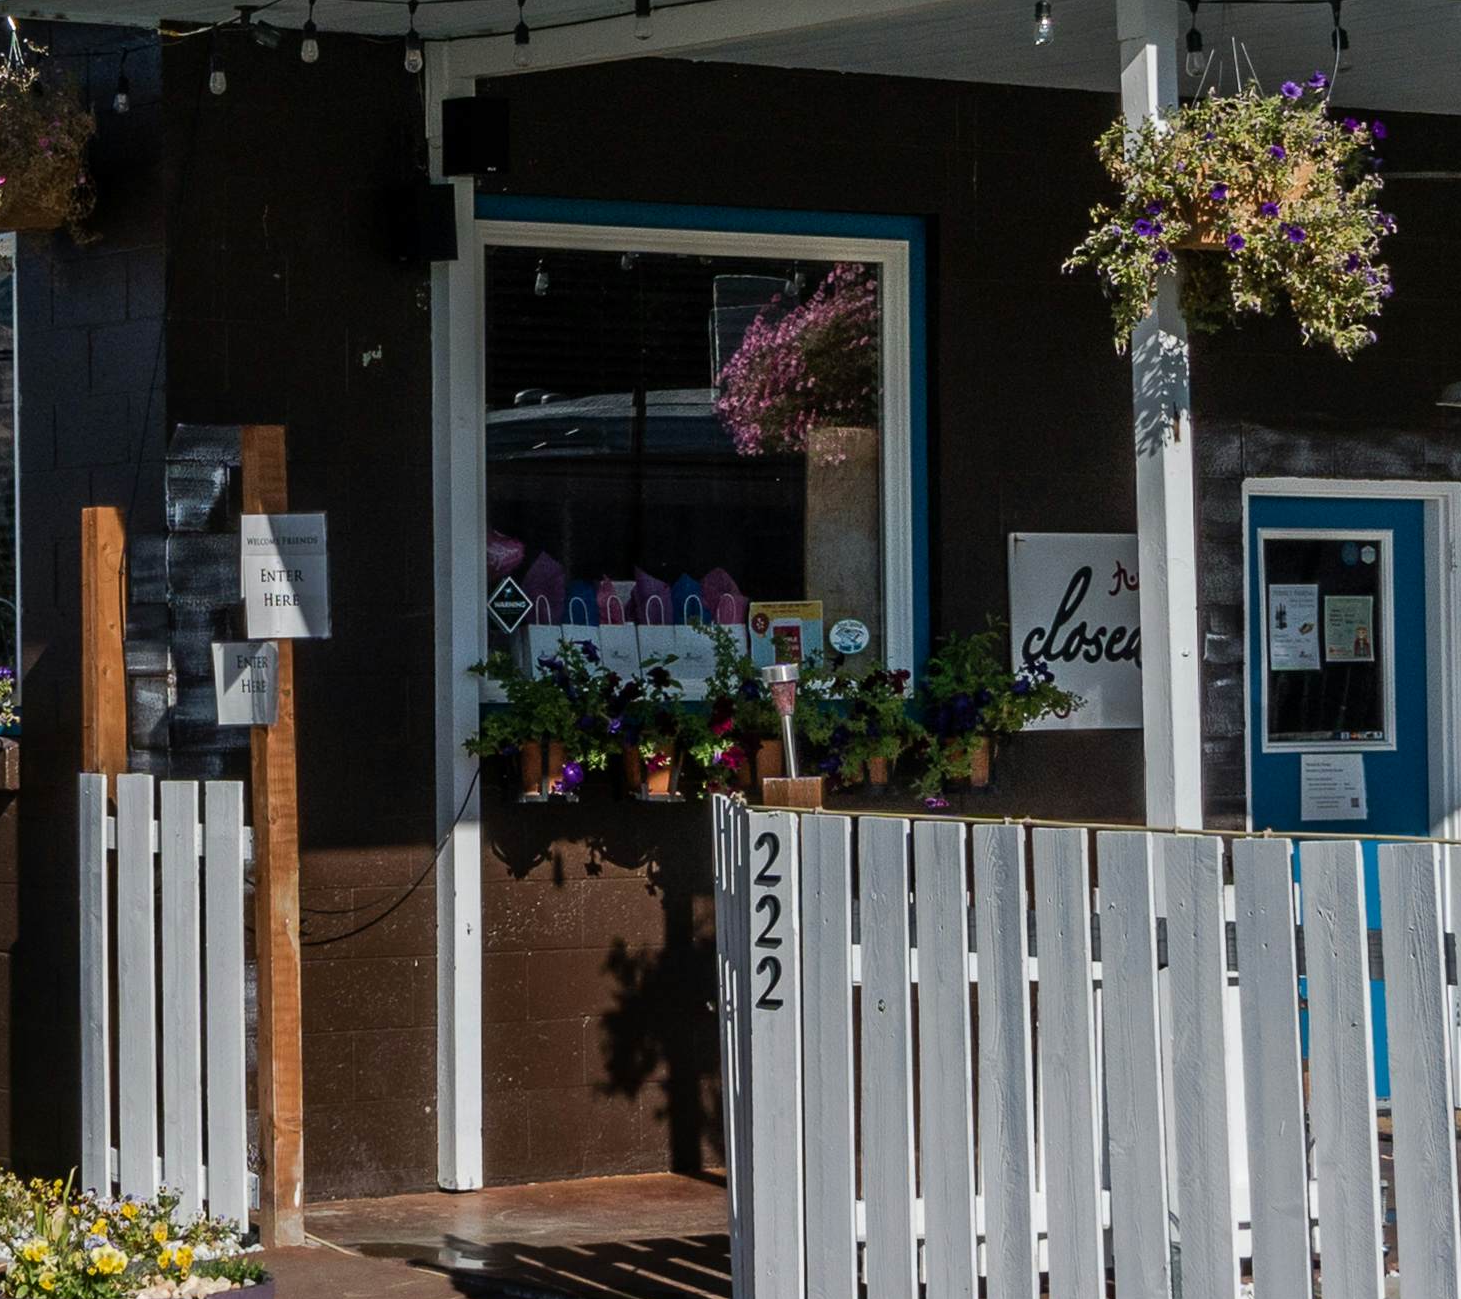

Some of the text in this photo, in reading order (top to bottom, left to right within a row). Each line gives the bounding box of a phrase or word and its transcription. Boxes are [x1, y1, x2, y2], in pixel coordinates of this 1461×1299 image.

[260, 568, 304, 582] ENTER
[264, 592, 301, 607] HERE
[236, 654, 268, 669] ENTER
[241, 679, 267, 694] HERE
[753, 831, 784, 1011] 222
